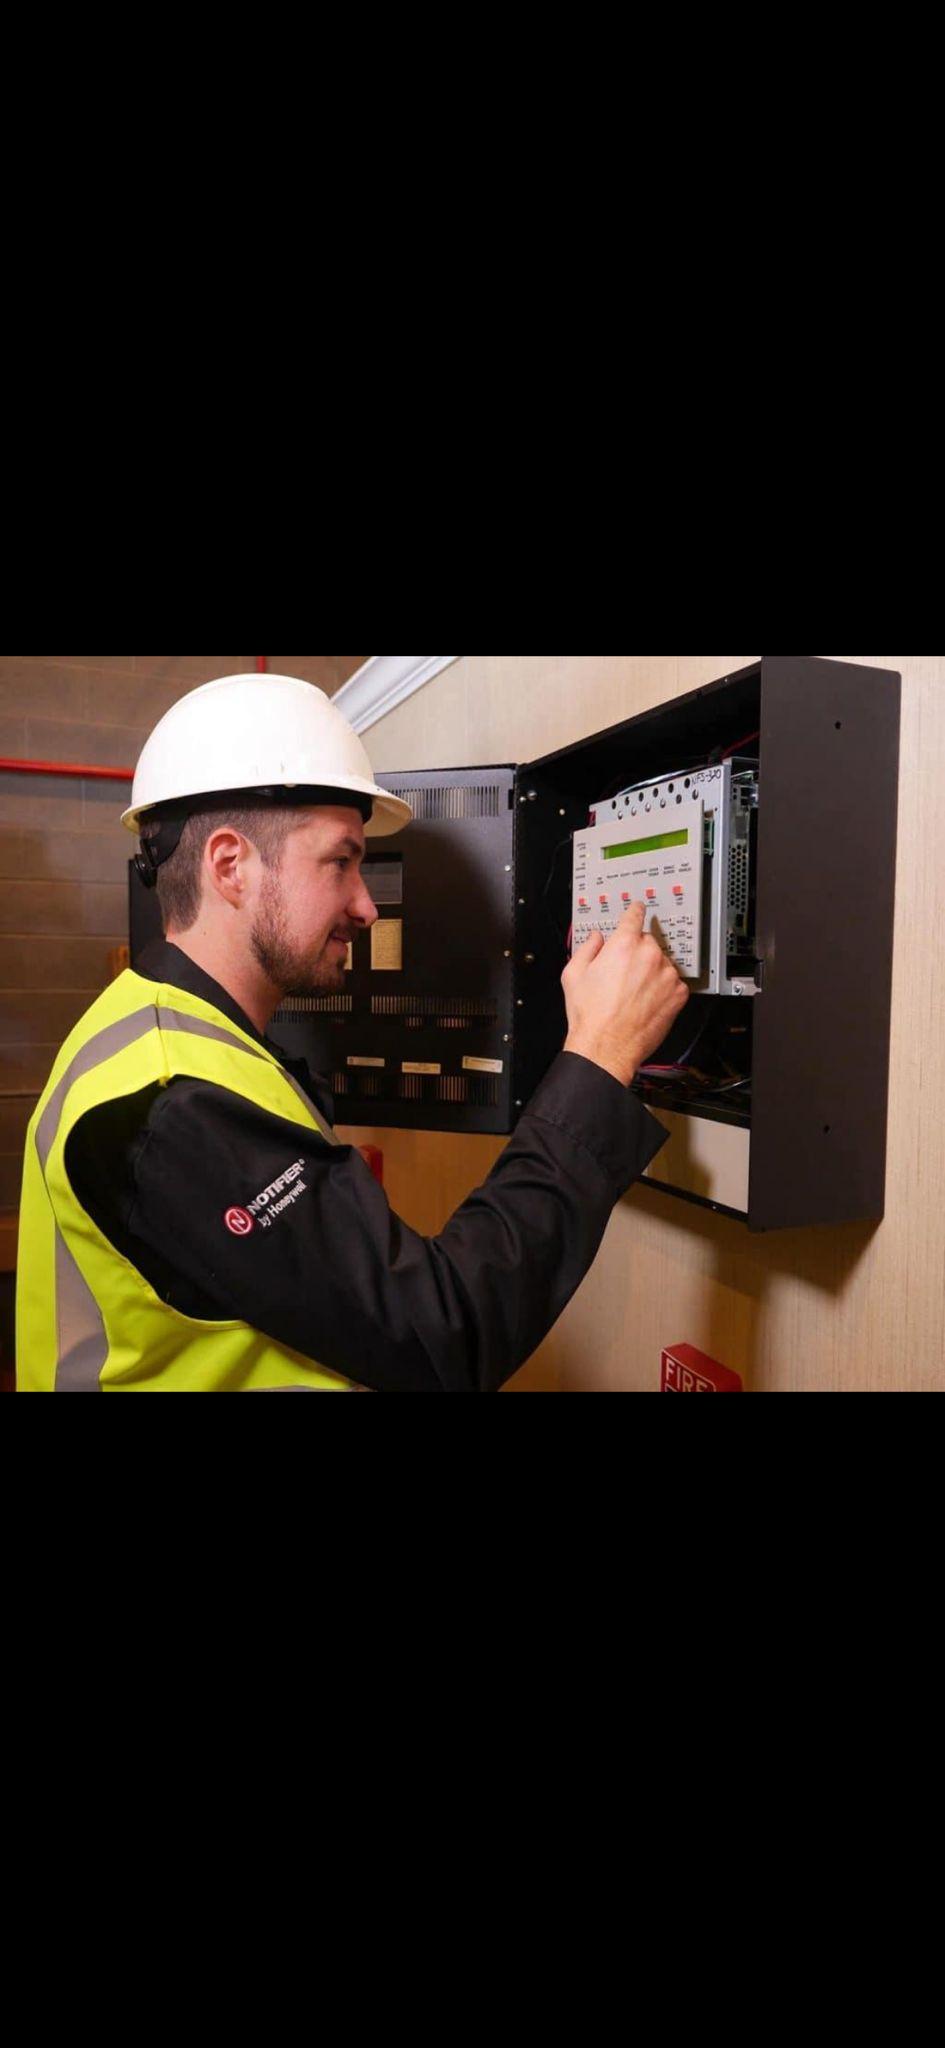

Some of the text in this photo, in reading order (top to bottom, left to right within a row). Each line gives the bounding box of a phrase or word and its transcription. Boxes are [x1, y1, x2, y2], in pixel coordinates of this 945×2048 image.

[257, 1179, 307, 1227] by Honeywell
[666, 1358, 708, 1392] FIRE
